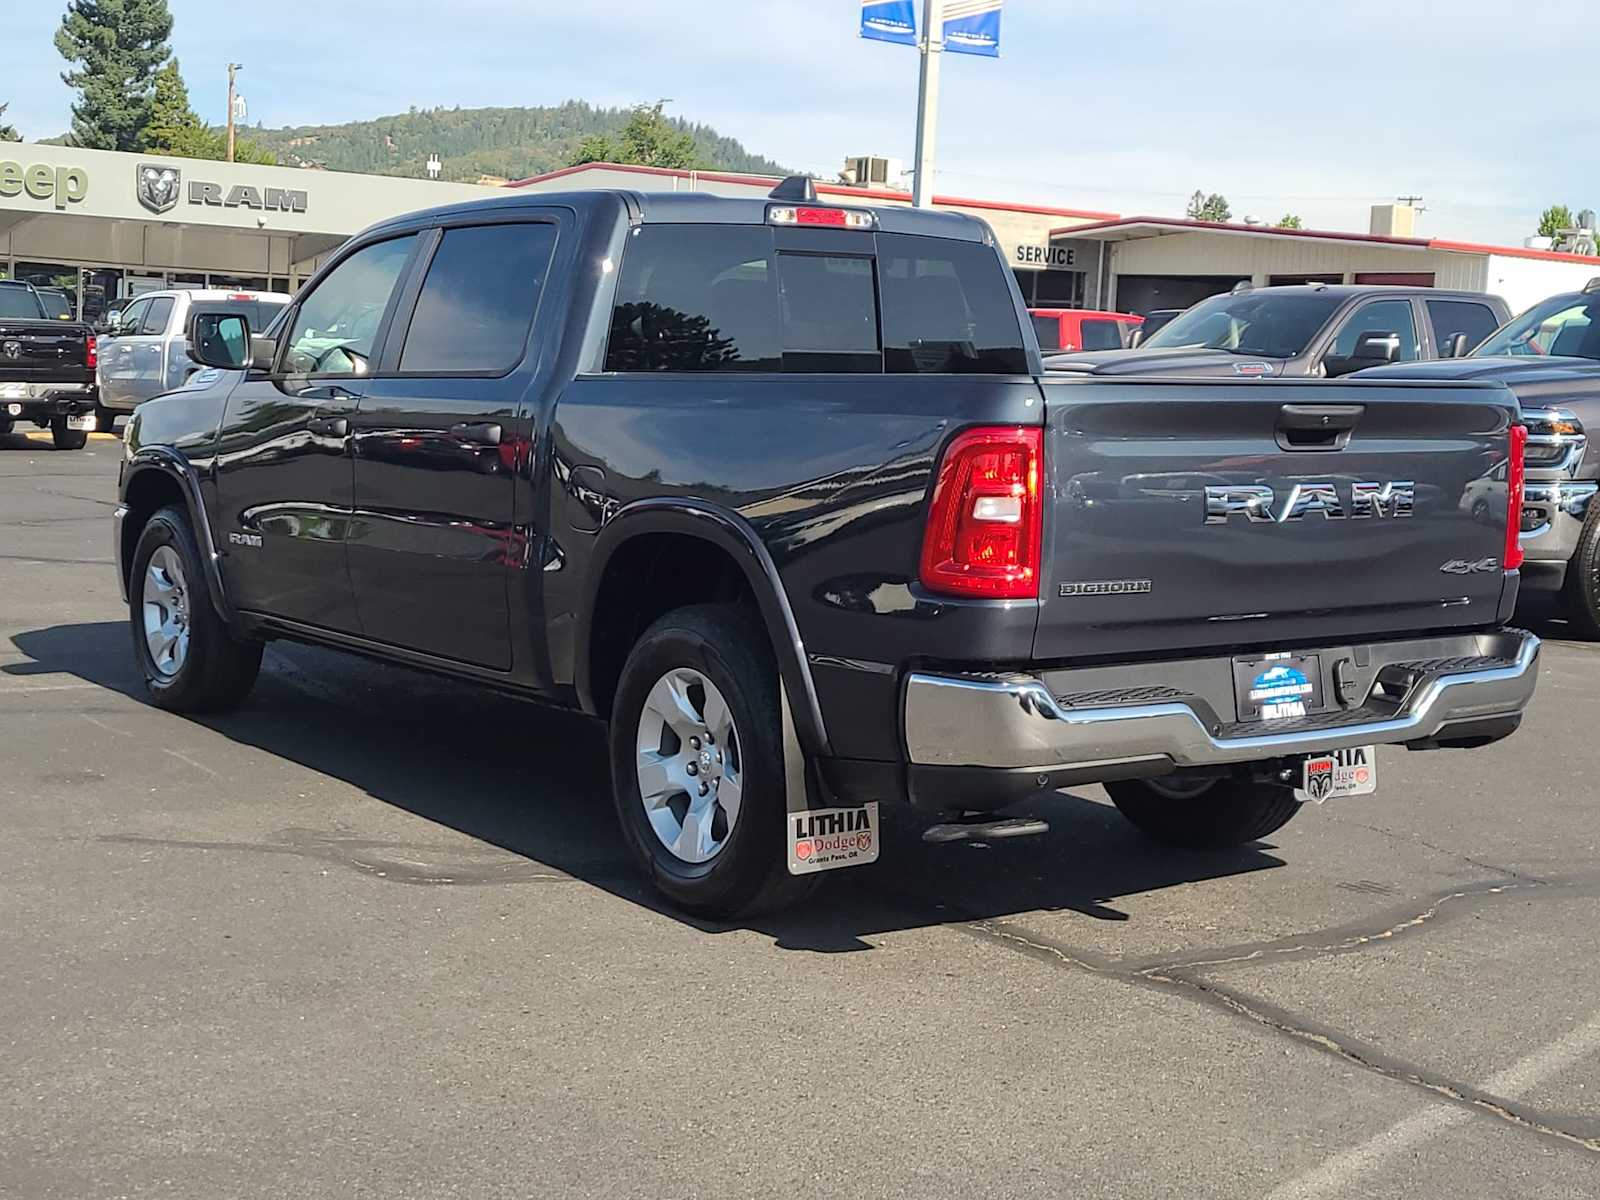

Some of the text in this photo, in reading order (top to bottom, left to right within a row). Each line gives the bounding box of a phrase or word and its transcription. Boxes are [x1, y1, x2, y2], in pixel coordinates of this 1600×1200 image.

[0, 161, 88, 210] eep
[188, 180, 308, 213] RAM
[1016, 245, 1074, 265] SERVICE
[1204, 481, 1415, 524] RAM
[228, 532, 263, 547] RAM
[1059, 581, 1152, 597] BIGHORN
[796, 809, 870, 839] LITHIA
[814, 836, 856, 852] Dodge
